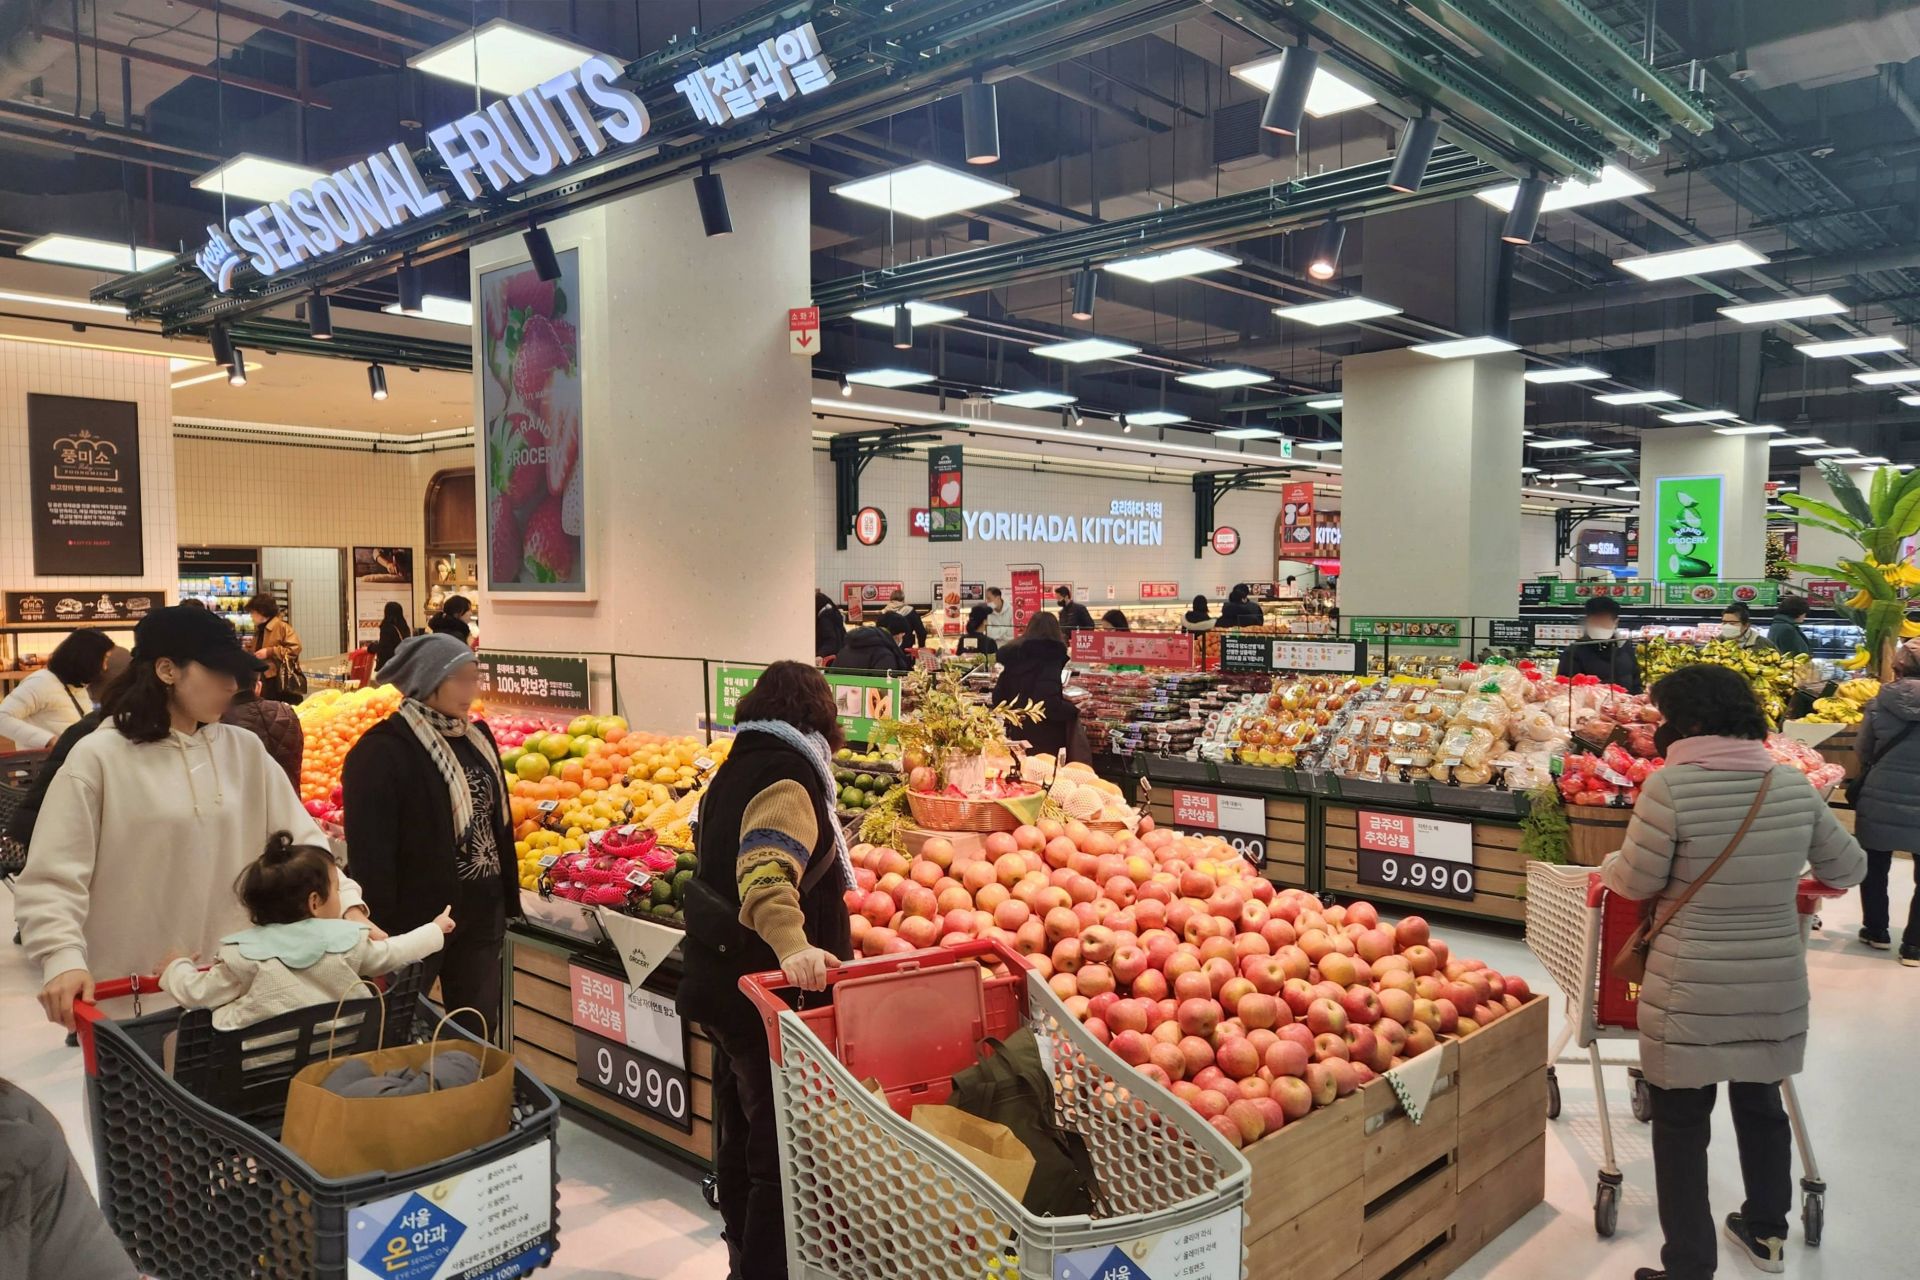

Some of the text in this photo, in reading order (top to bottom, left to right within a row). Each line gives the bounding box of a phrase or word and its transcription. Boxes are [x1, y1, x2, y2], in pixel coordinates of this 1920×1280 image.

[675, 25, 836, 127] 계절과일
[195, 55, 651, 283] Fresh SEASONAL FRUITS
[61, 448, 110, 465] 풍미소
[1110, 499, 1162, 519] 요리하다 키친
[962, 510, 1162, 546] YORIHADA KITCHEN
[1667, 536, 1708, 544] GROCERY
[496, 676, 520, 693] 100%
[520, 678, 548, 697] 맛보장
[1182, 795, 1209, 808] 금주의
[1178, 807, 1215, 823] 추천상품
[1369, 816, 1403, 832] 금주의
[1365, 830, 1410, 849] 추천상품
[1381, 858, 1473, 894] 9,990
[629, 955, 649, 968] GROCERY
[581, 975, 614, 1005] 금주의
[577, 999, 622, 1032] 추천상품
[663, 1006, 675, 1017] 망고
[597, 1047, 686, 1118] 9,990
[399, 1207, 432, 1230] 서울
[1200, 1228, 1212, 1239] 라식
[382, 1223, 448, 1272] 온 안과
[410, 1246, 450, 1266] SEOUL ON
[410, 1261, 437, 1276] CLINIC
[497, 1263, 521, 1280] 100m
[1183, 1263, 1206, 1277] 드림렌즈
